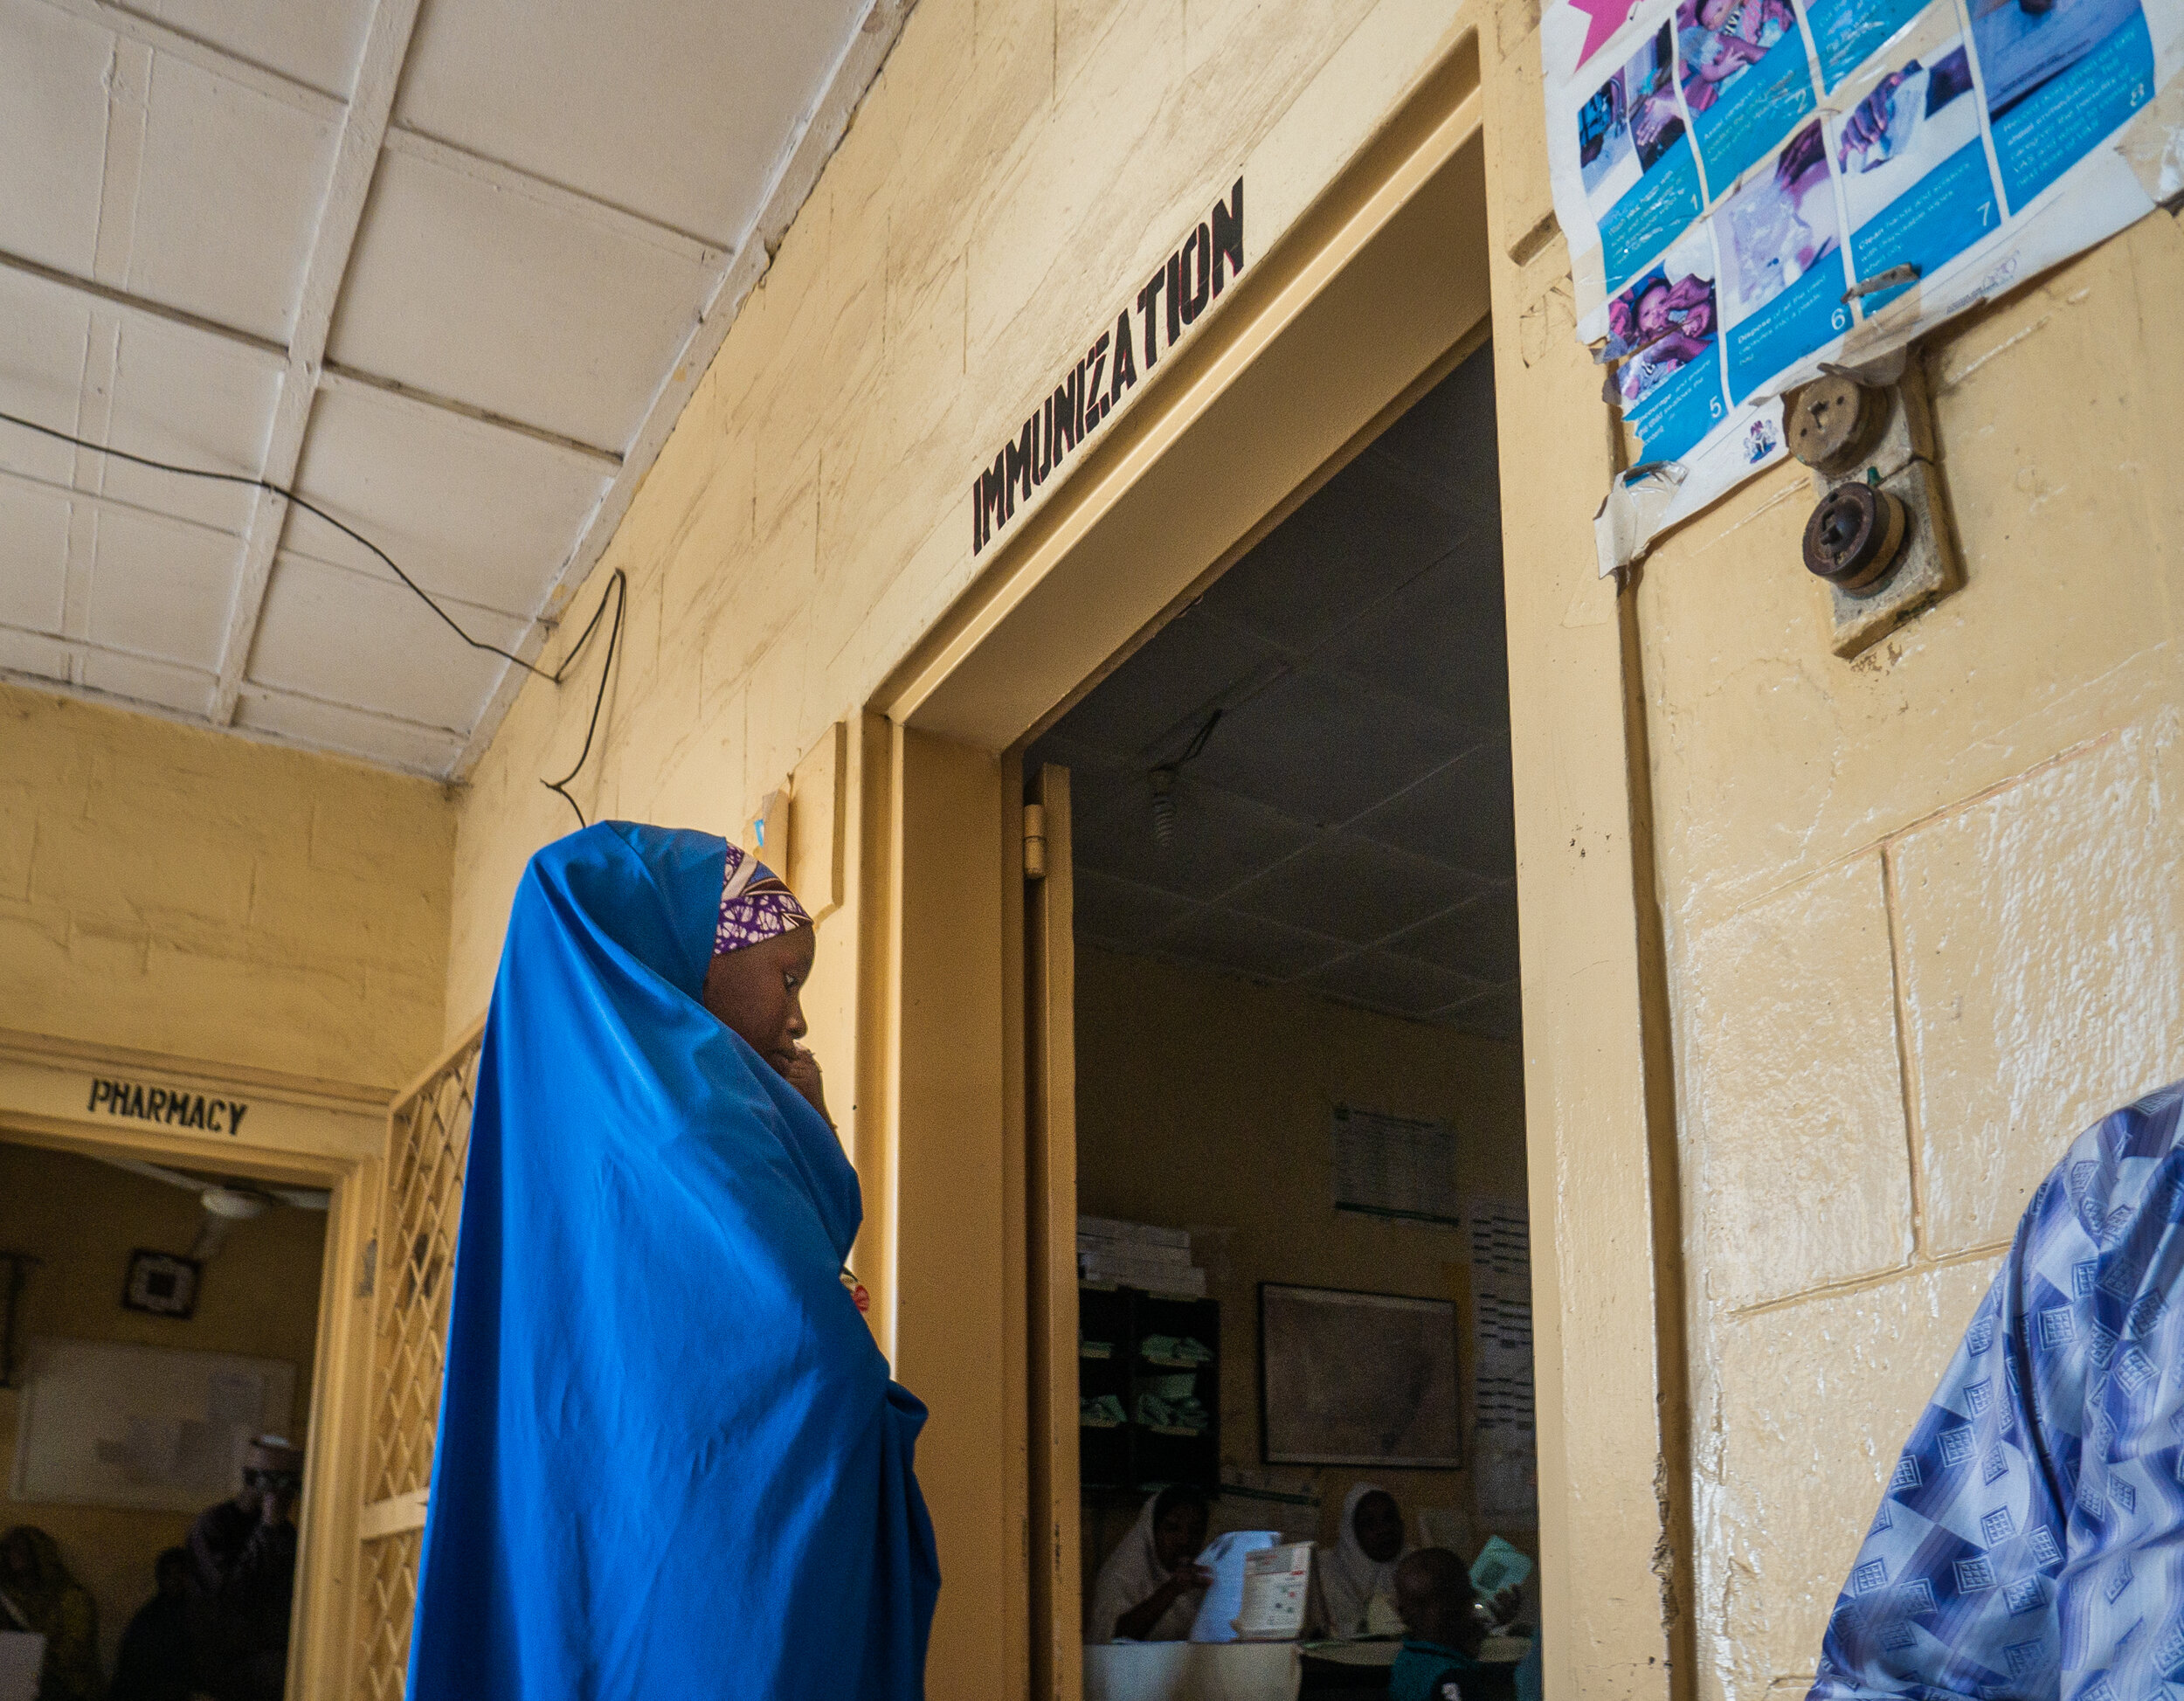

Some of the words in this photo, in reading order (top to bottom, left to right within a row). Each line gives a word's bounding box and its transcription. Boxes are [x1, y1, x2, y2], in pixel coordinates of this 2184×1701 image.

[2130, 82, 2145, 107] 8
[1690, 193, 1698, 211] 1
[1977, 200, 1991, 227] 7
[1831, 308, 1846, 330] 6
[973, 175, 1244, 557] IMMUNIZATION
[1710, 395, 1722, 418] 5
[87, 1078, 248, 1136] PHARMACY
